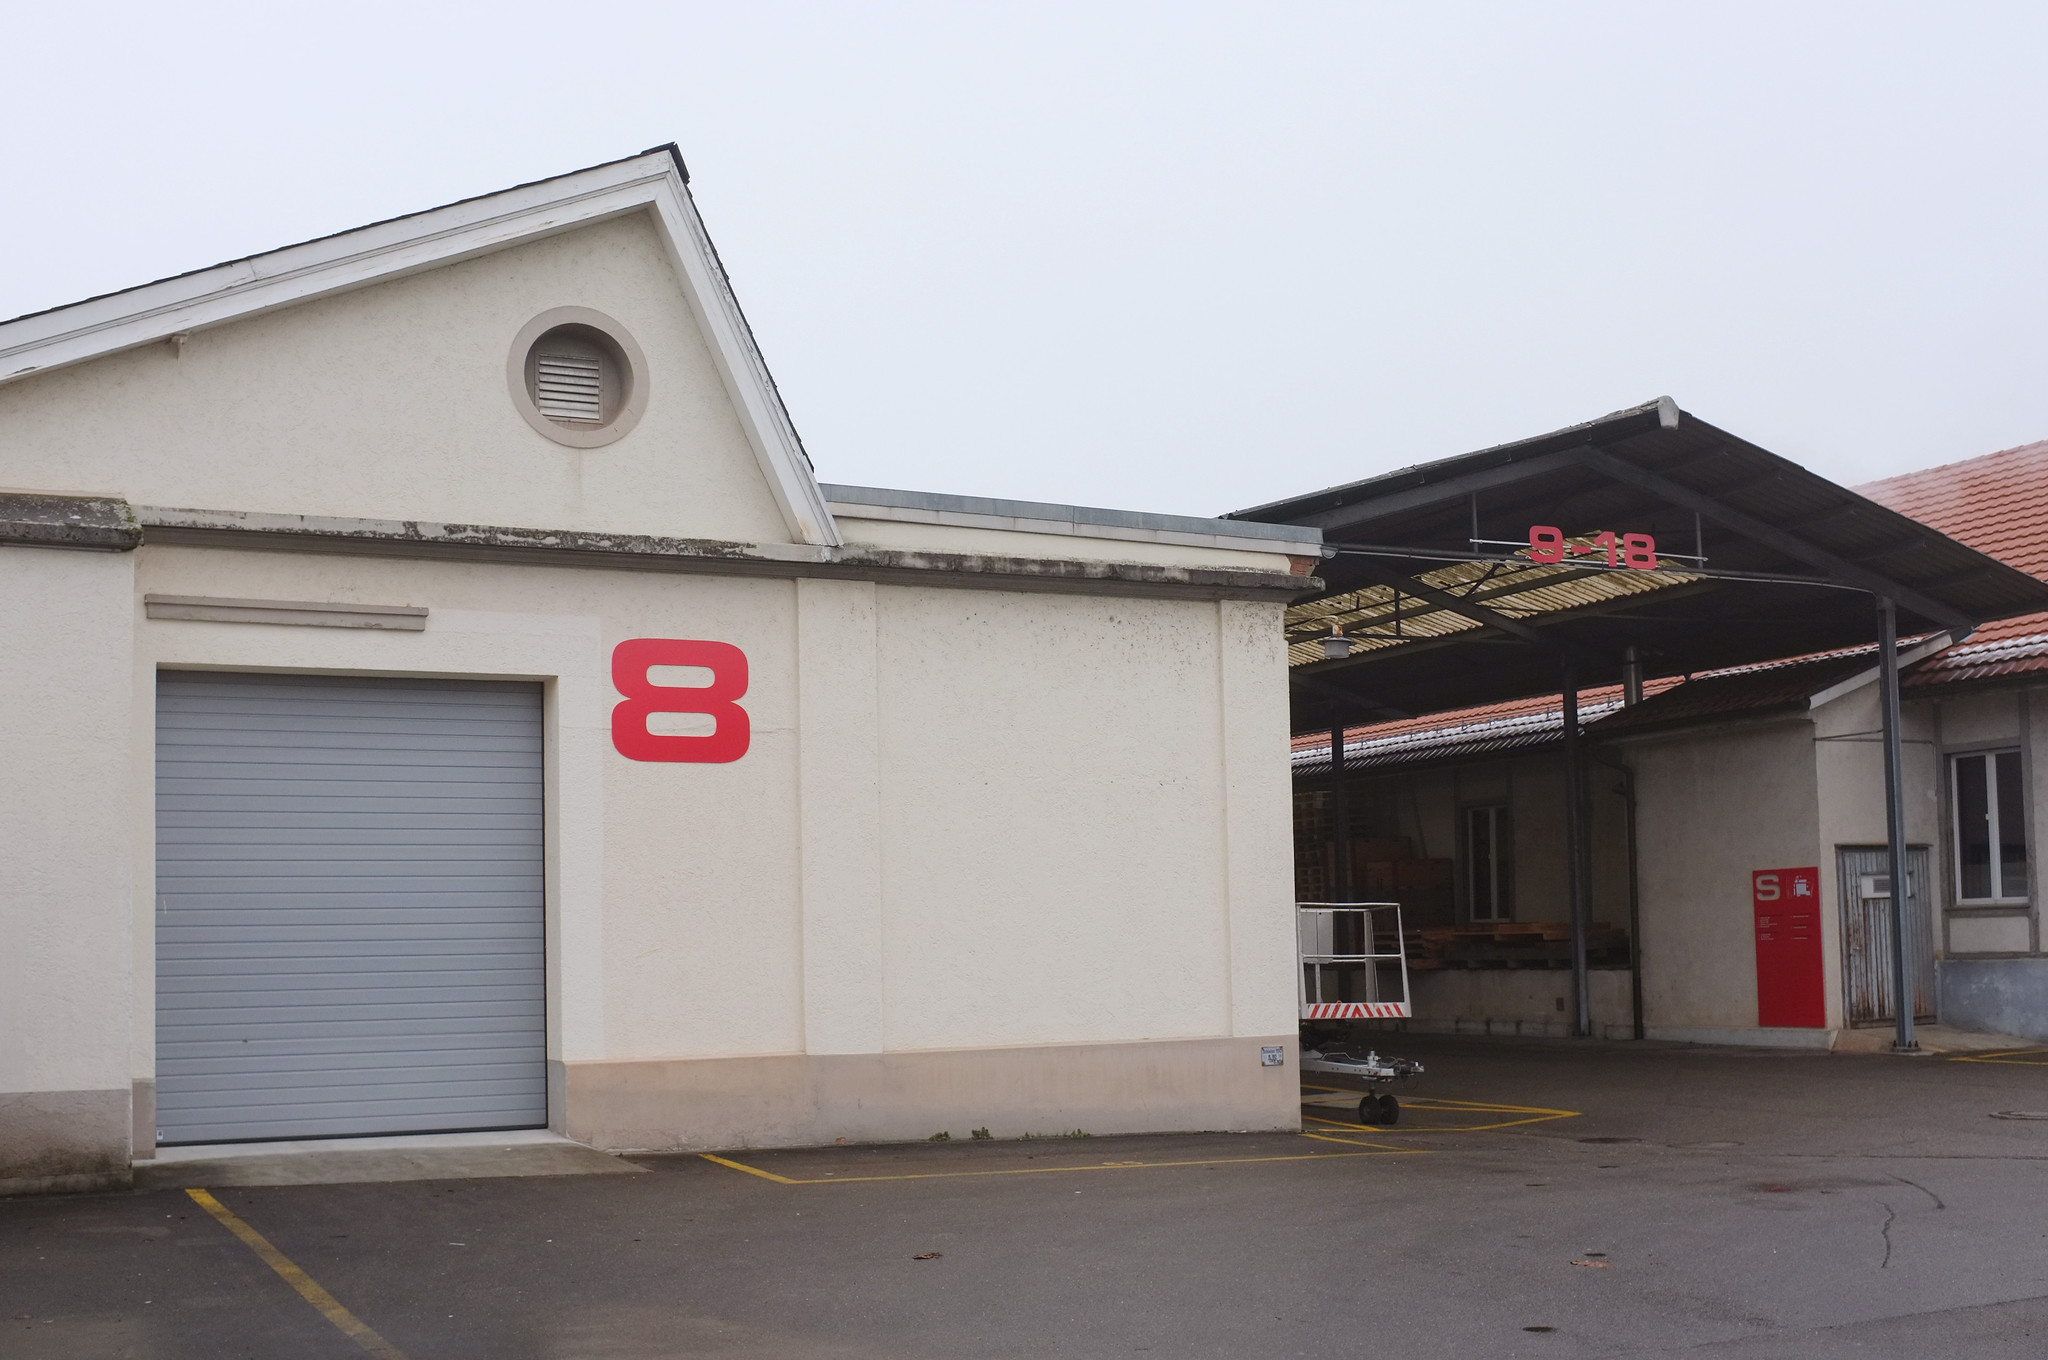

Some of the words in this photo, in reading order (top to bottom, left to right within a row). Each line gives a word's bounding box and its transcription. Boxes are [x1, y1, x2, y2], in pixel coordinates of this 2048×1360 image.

[1529, 525, 1657, 570] 9-18
[611, 638, 750, 764] 8
[1756, 873, 1781, 901] S
